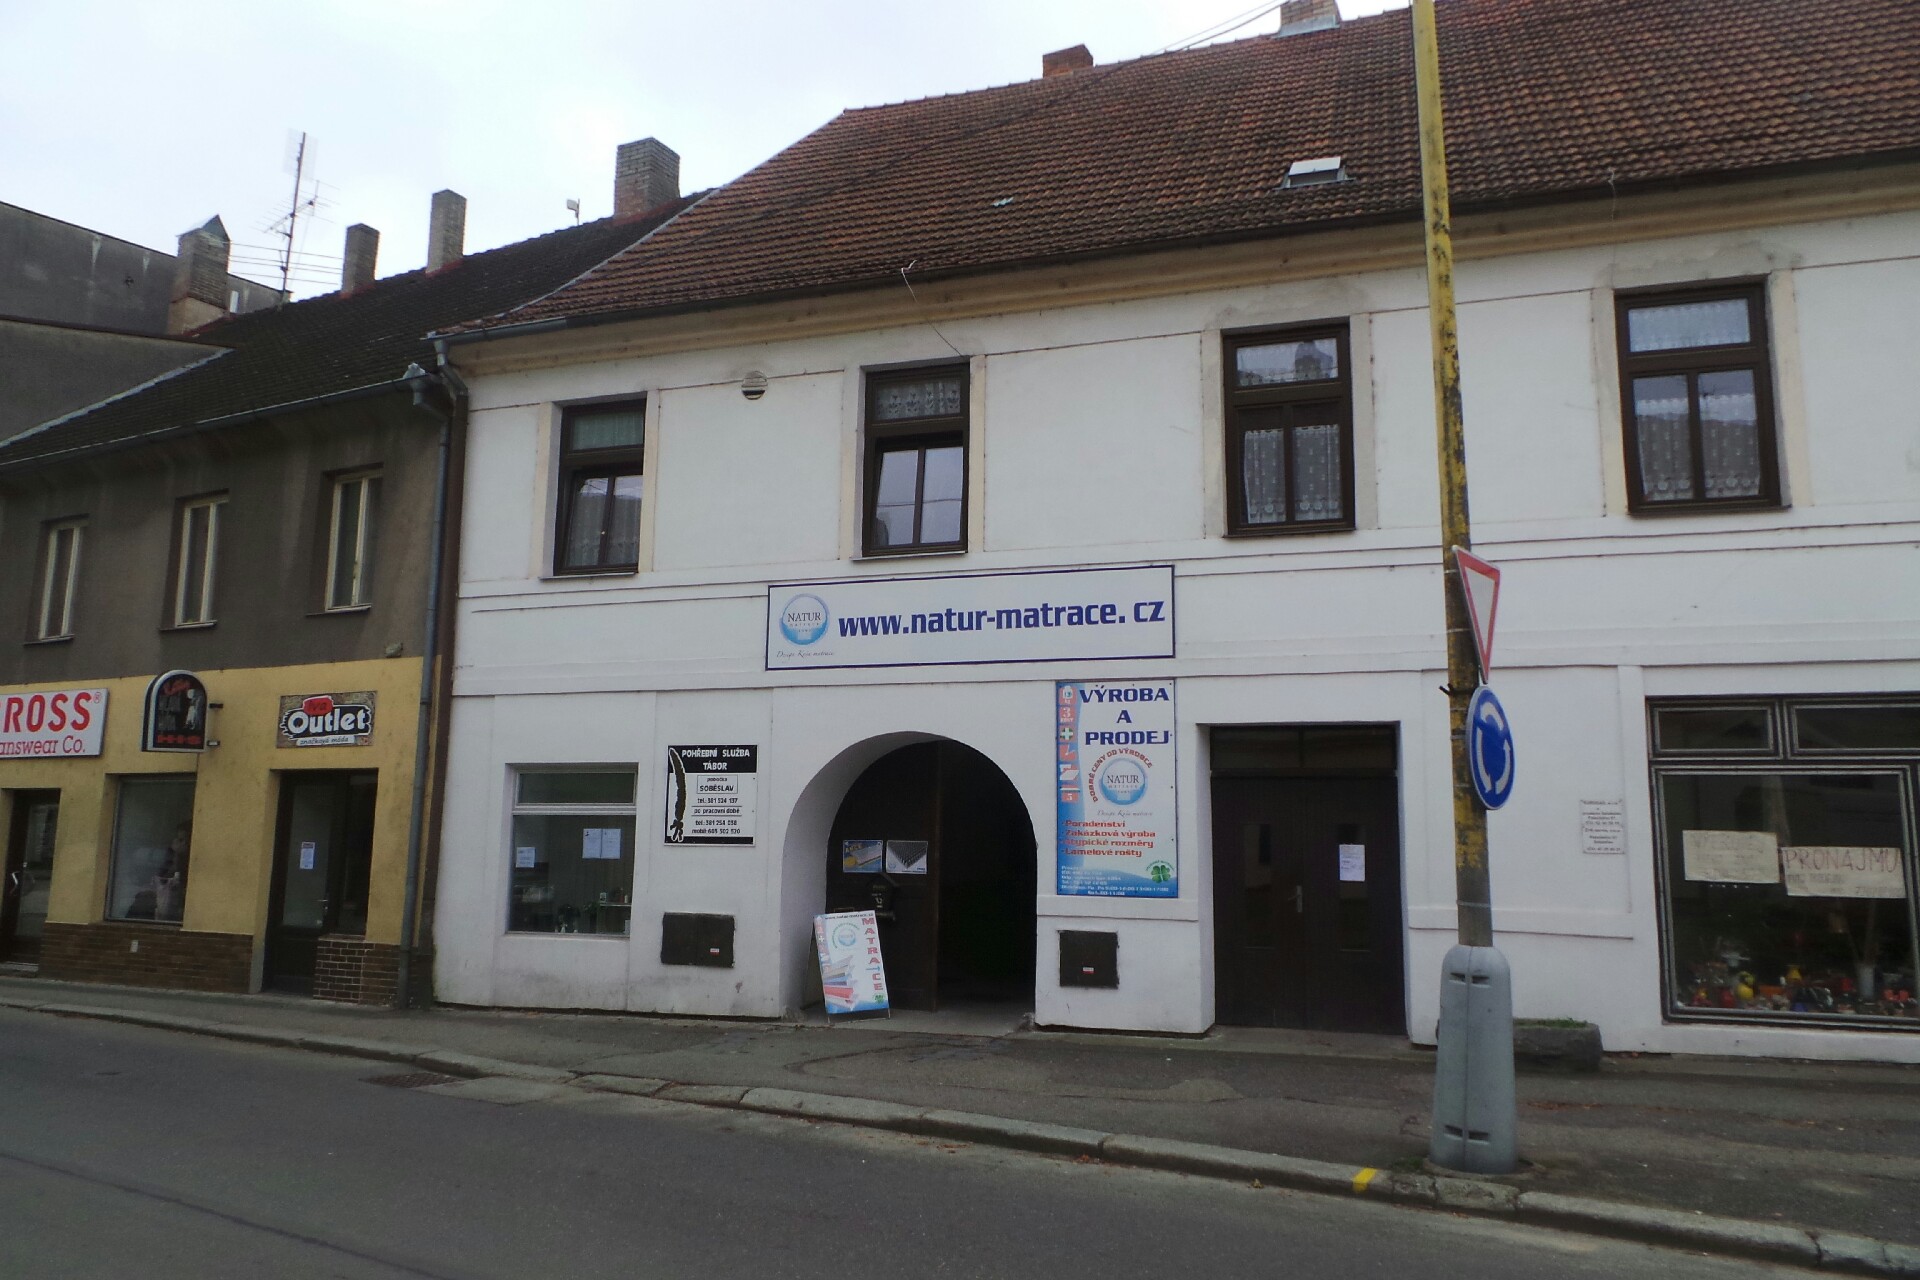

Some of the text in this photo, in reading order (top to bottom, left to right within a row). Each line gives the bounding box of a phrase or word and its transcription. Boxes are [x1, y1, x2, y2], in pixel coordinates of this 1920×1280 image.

[788, 612, 821, 622] NATUR
[1080, 685, 1169, 703] VÝROBA
[0, 692, 92, 732] ROSS
[1116, 709, 1132, 723] A
[287, 708, 366, 733] Outlet
[1085, 730, 1169, 745] PRODEJ
[62, 735, 86, 753] Co.
[682, 747, 750, 757] POHŘEBNÍ SLUŽBA
[703, 760, 727, 770] TÁBOR
[1092, 755, 1106, 773] CENY
[1106, 749, 1118, 758] OD
[1107, 774, 1139, 784] NATUR
[700, 784, 734, 792] SOBĚSLAV
[1121, 830, 1156, 839] výroba
[1111, 839, 1154, 848] rozměry
[1065, 848, 1142, 857] Lamelové rošty
